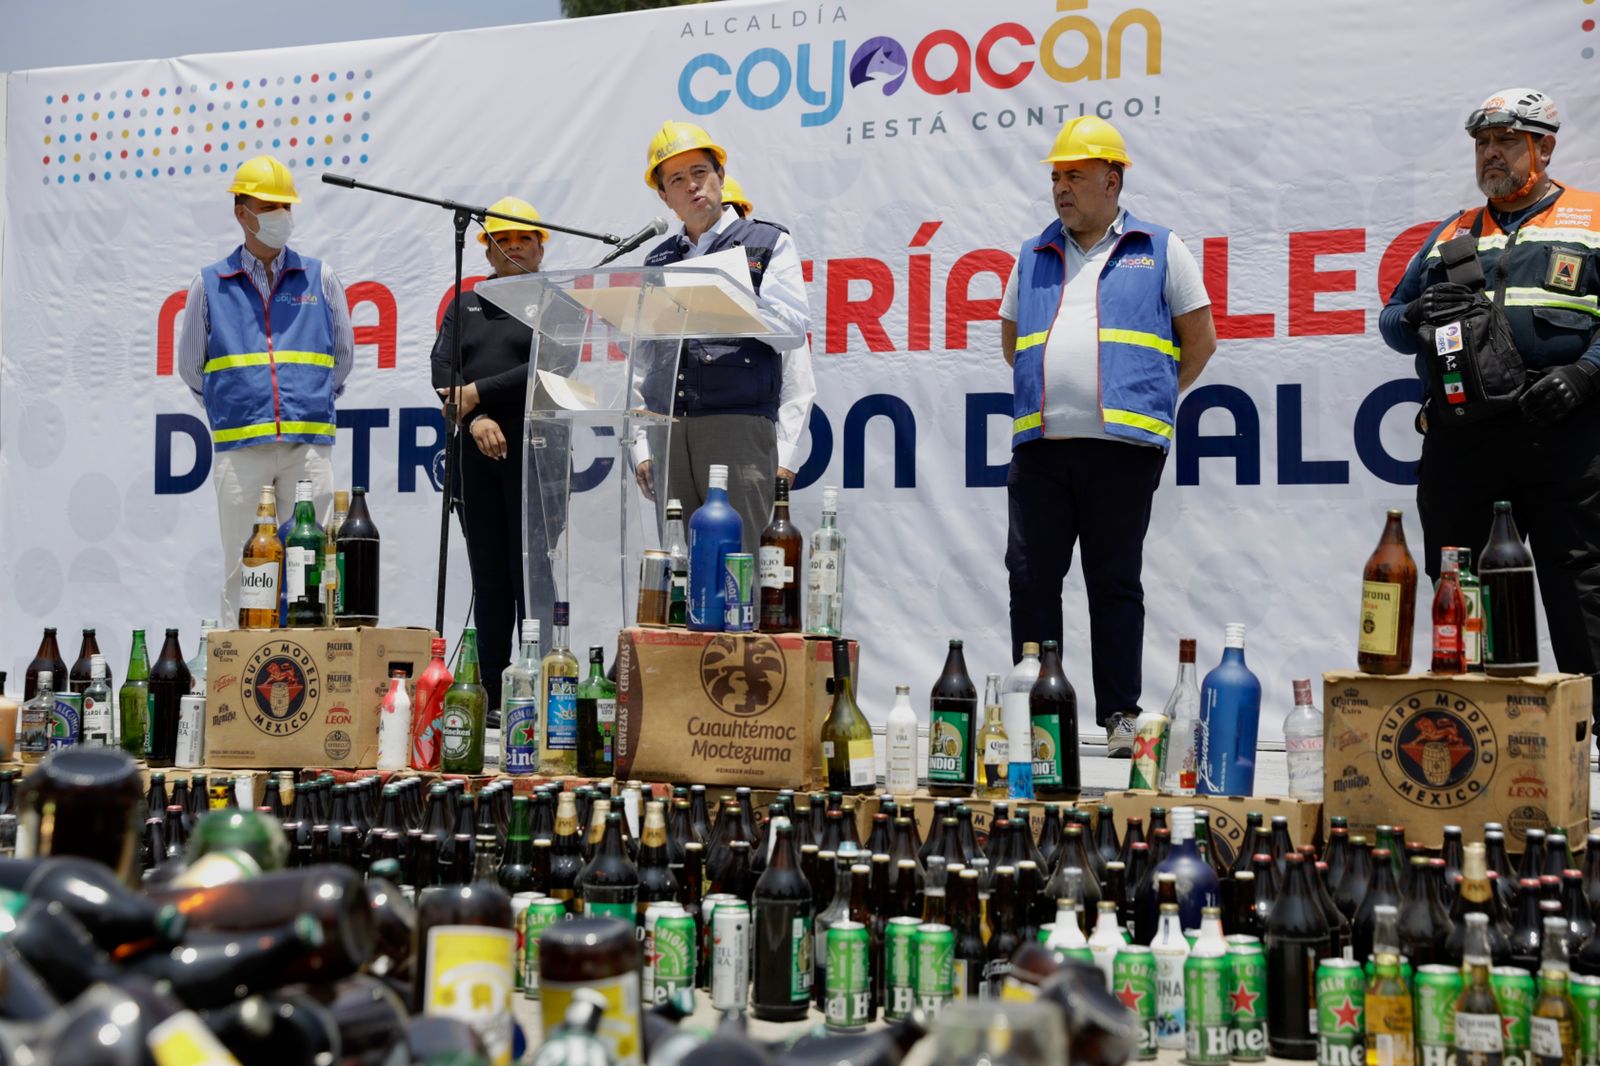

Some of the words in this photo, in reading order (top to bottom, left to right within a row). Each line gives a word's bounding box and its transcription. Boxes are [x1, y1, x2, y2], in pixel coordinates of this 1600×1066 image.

[680, 4, 848, 38] ALCALDÍA
[846, 110, 948, 145] ¡ESTÁ
[971, 95, 1162, 131] CONTIGO!
[241, 571, 273, 588] odelo
[244, 647, 271, 698] GRUPO
[280, 643, 317, 698] MODELO
[619, 643, 631, 692] CERVEZAS
[617, 707, 629, 756] CERVEZAS
[687, 716, 797, 741] Cuauhtémoc
[691, 739, 792, 764] Moctezuma
[1381, 697, 1421, 760] GRUPO
[1435, 693, 1494, 764] MODELO
